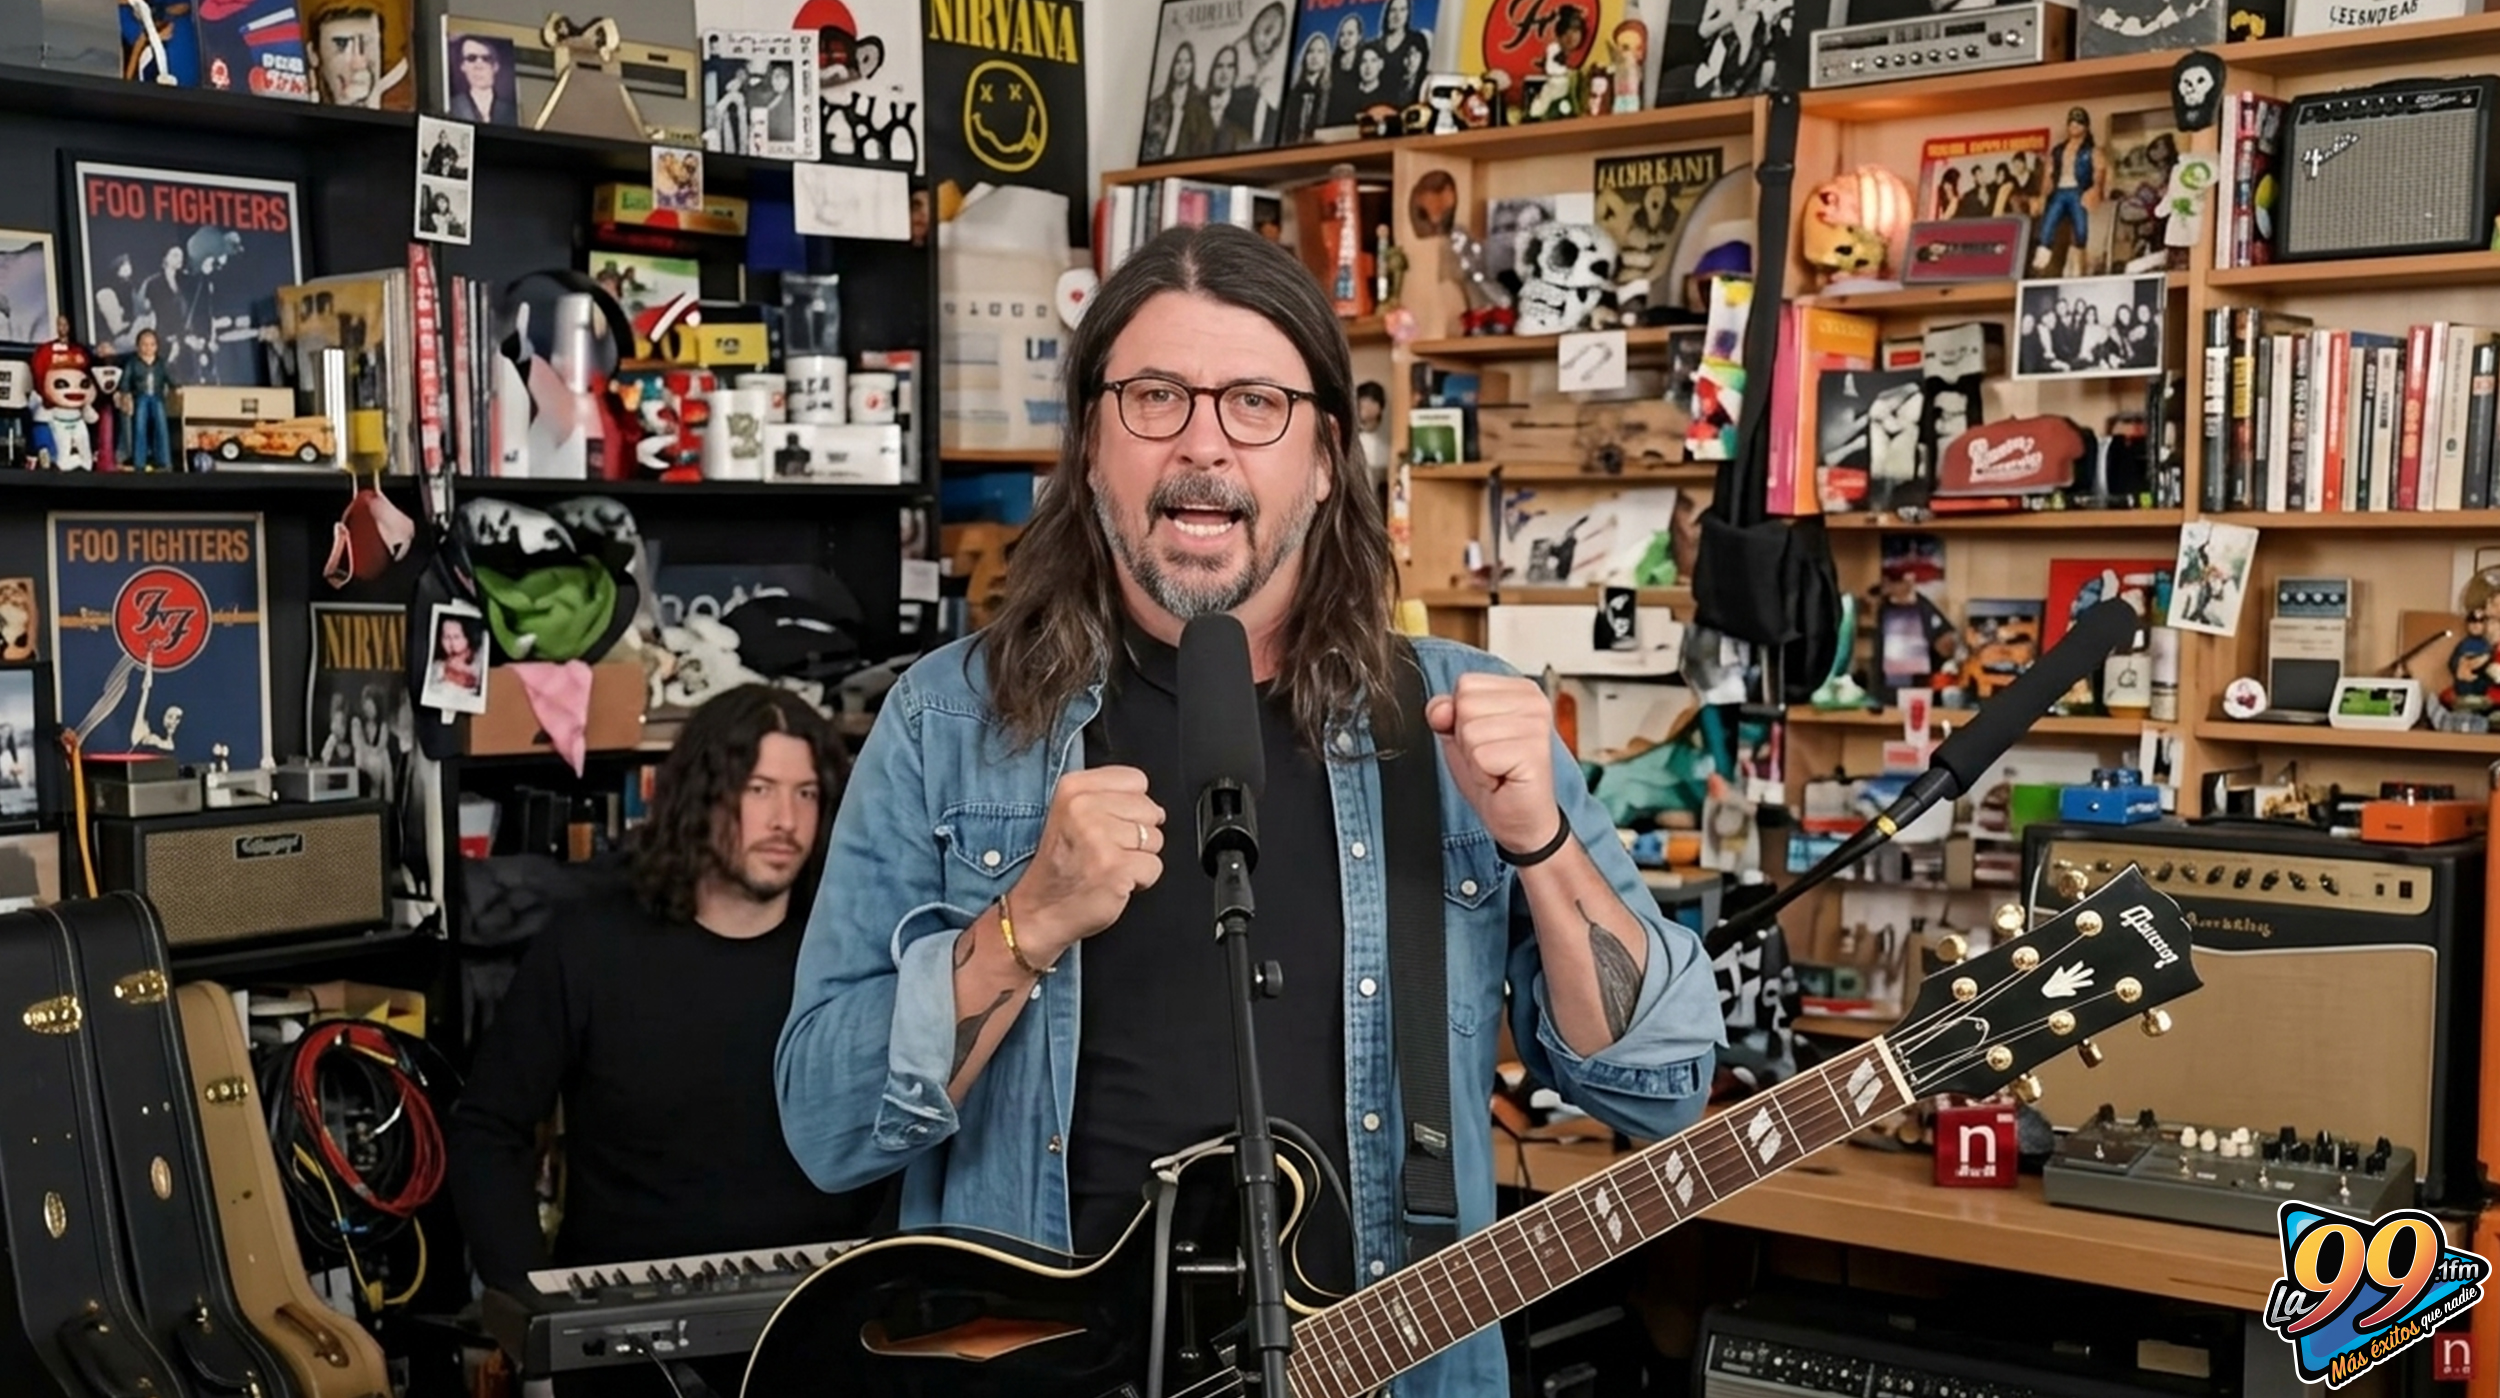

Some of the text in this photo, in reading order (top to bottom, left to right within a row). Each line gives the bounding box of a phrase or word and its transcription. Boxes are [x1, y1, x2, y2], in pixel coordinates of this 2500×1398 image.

[929, 0, 1078, 63] NIRVANA
[88, 179, 288, 231] FOO FIGHTERS
[67, 529, 249, 562] FOO FIGHTERS
[322, 614, 406, 671] NIRVA
[1959, 1125, 1996, 1163] n
[2443, 1339, 2470, 1365] n
